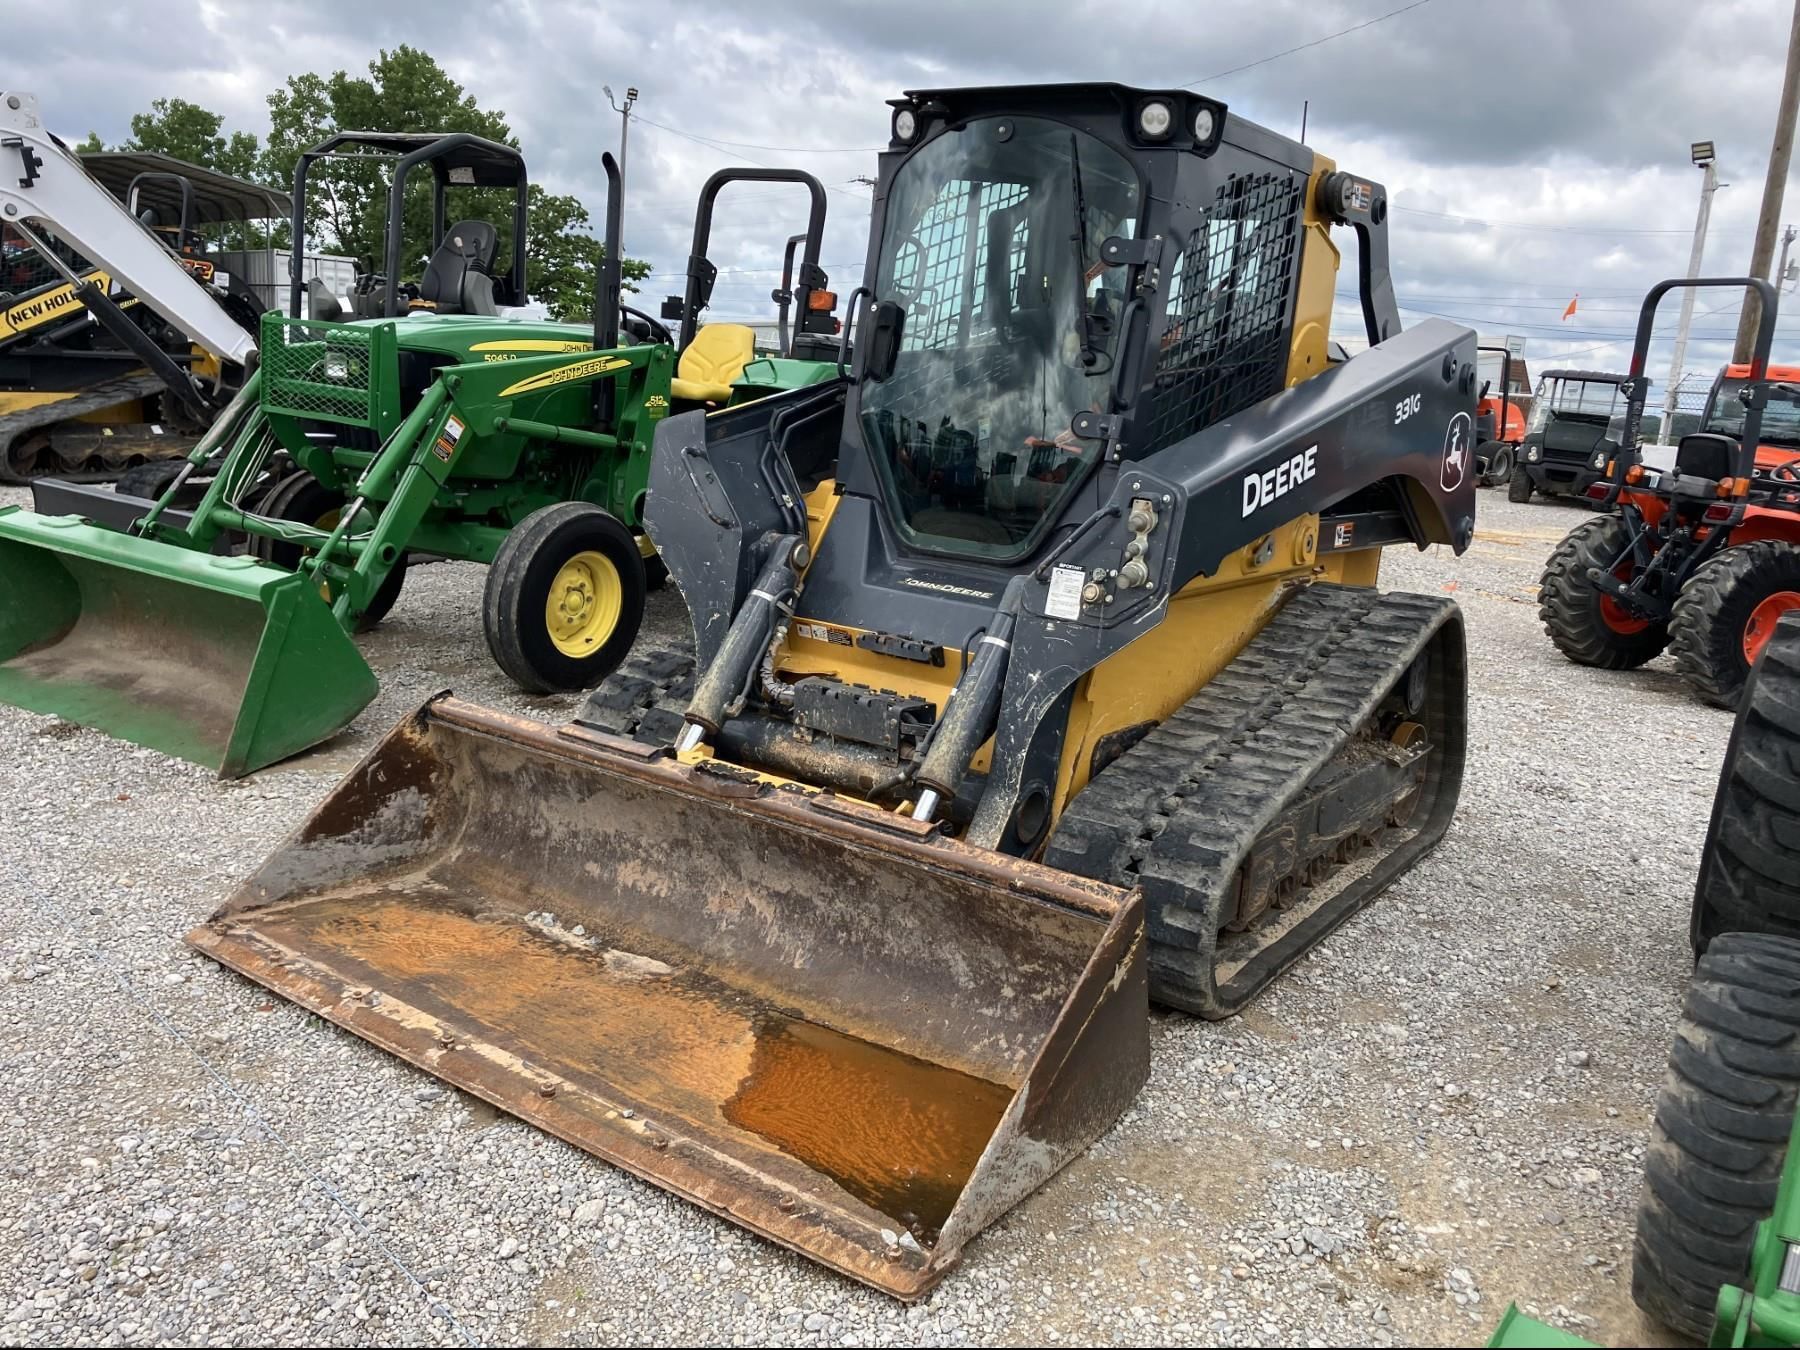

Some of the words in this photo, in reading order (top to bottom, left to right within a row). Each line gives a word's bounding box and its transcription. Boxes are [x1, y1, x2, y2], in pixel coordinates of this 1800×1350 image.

[10, 302, 43, 325] NEW
[43, 278, 104, 312] HOLLD
[562, 343, 581, 352] JOHN
[549, 370, 577, 384] JOHN
[576, 360, 607, 377] DEERE
[650, 395, 664, 405] 512
[1394, 393, 1421, 425] 331G
[1242, 444, 1318, 518] DEERE
[899, 577, 942, 590] JOHN
[940, 584, 994, 599] DEERE
